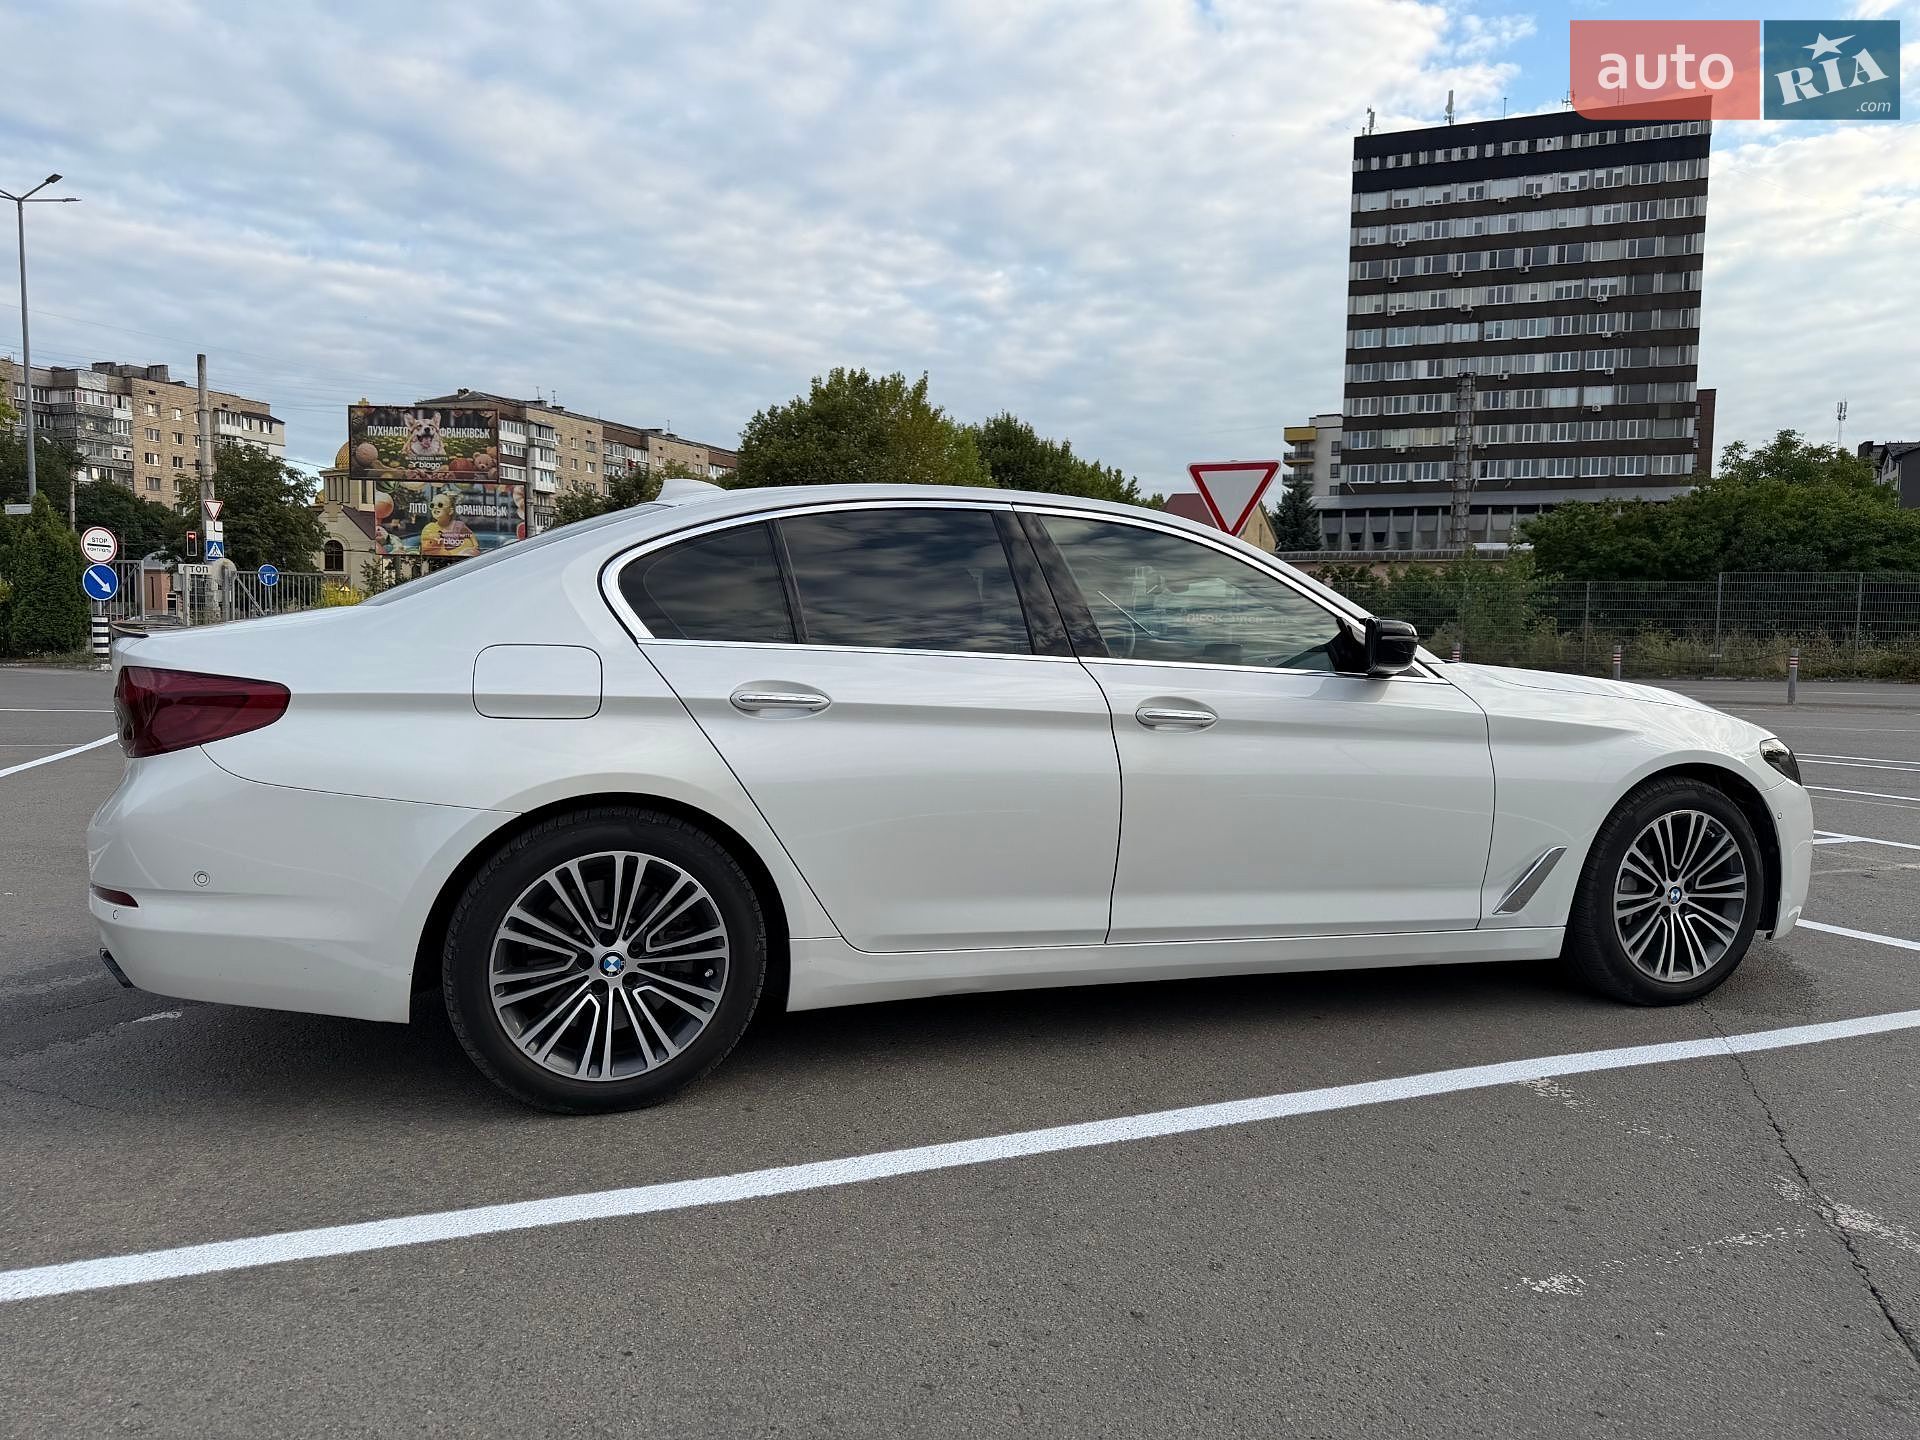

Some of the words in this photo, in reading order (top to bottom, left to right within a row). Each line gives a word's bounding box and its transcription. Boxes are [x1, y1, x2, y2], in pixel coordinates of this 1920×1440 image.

[367, 425, 409, 437] ПУХНАСТО
[439, 427, 490, 439] ФРАНКІВСЬК
[419, 461, 441, 470] blago
[408, 502, 427, 514] ЛІТО
[455, 504, 507, 517] ФРАНКІВСЬК
[182, 565, 209, 573] ТОП
